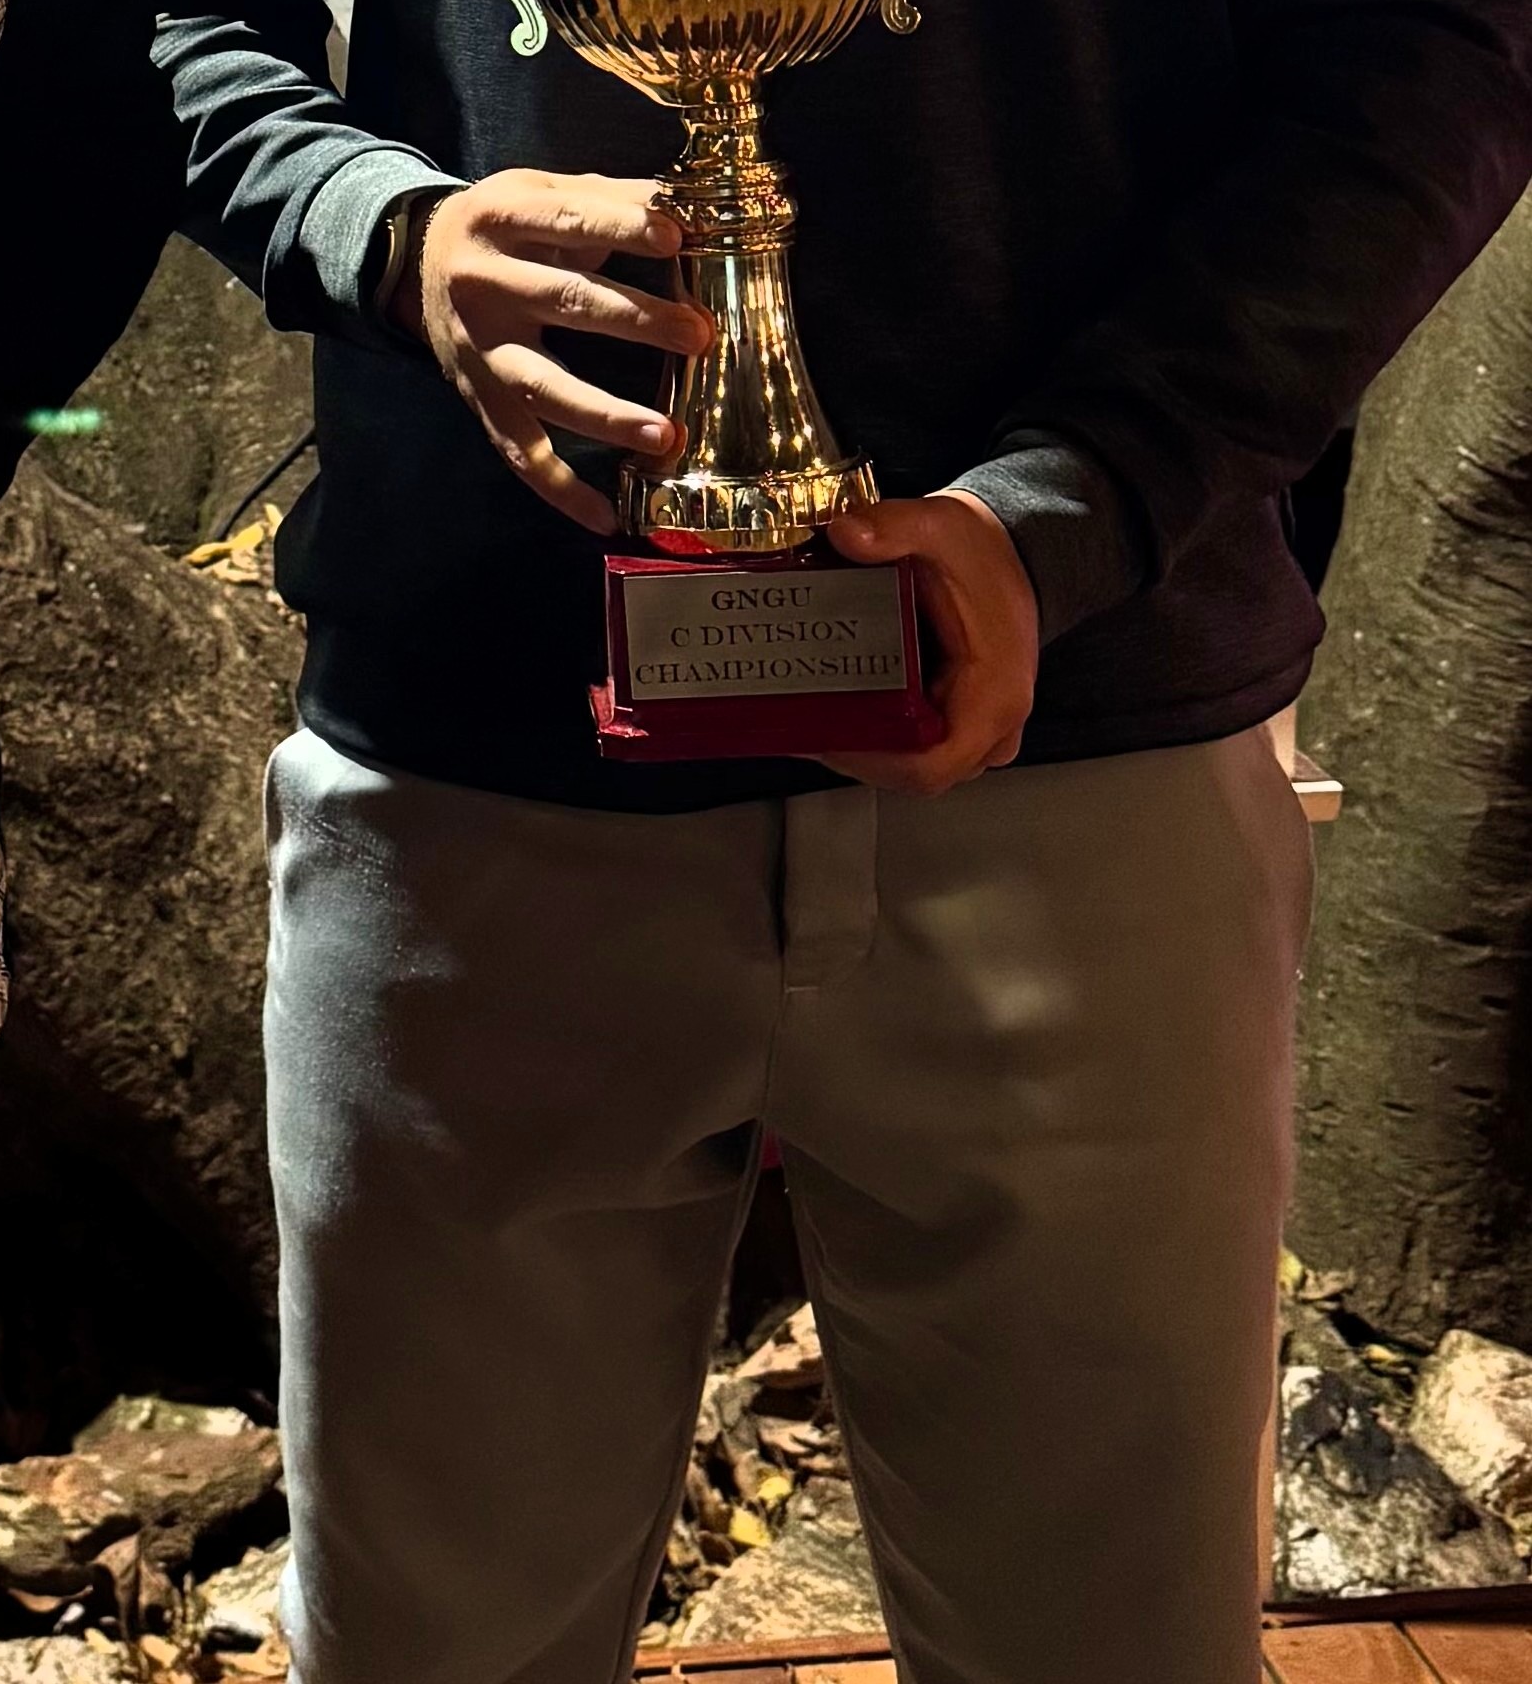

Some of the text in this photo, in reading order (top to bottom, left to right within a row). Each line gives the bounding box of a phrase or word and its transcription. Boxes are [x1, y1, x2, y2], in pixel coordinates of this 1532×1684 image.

[711, 586, 813, 611] GNGU
[670, 619, 859, 648] C DIVISION
[634, 653, 901, 685] CHAMPIONSHIP
